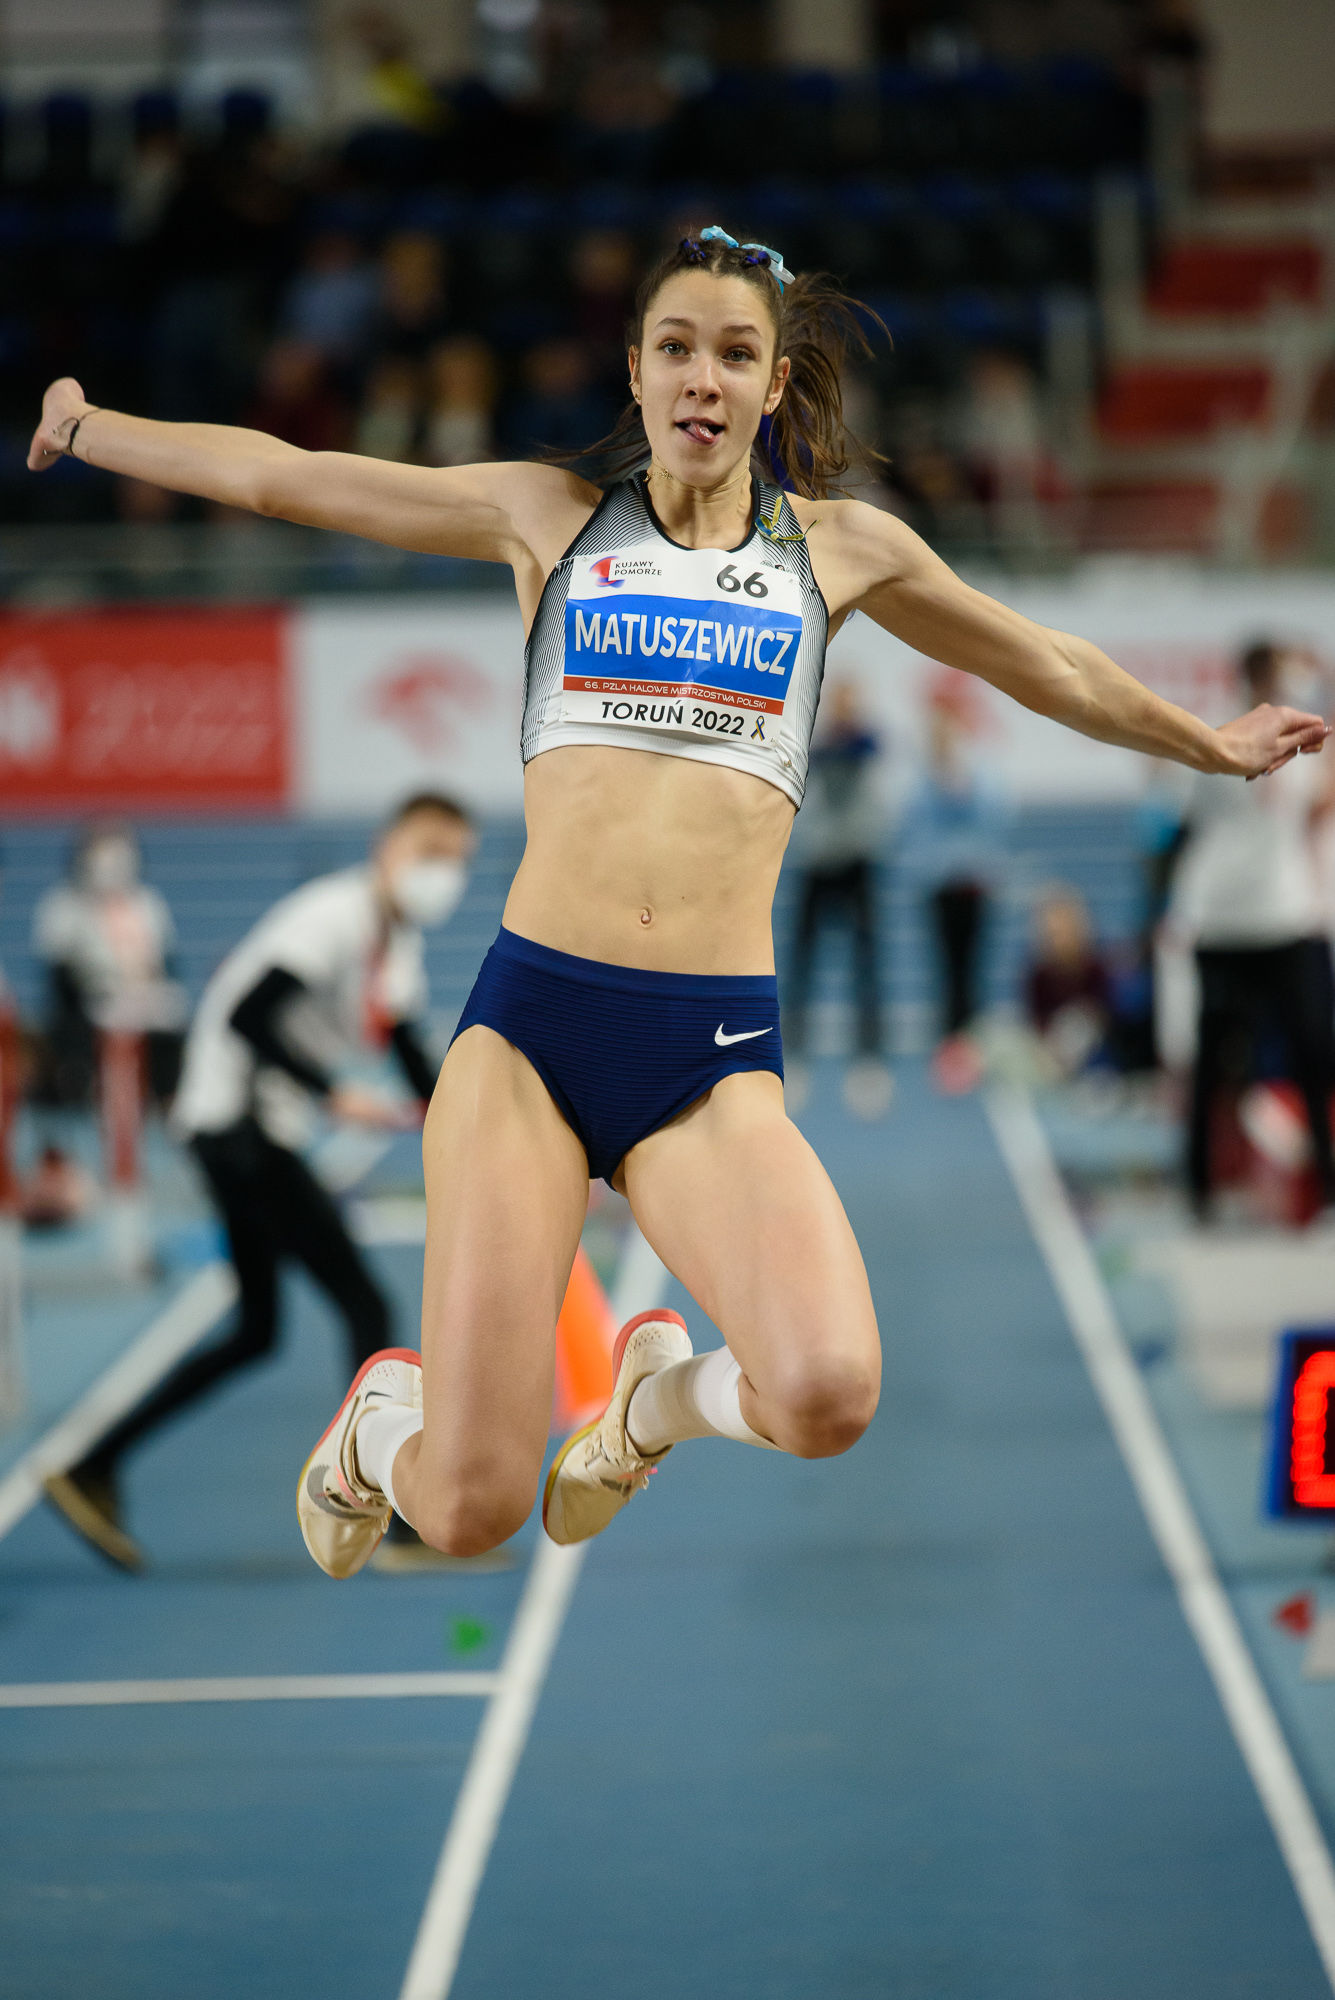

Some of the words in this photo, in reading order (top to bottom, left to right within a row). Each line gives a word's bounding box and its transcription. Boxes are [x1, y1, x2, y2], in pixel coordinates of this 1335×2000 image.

[614, 568, 663, 576] POMORZE
[615, 561, 654, 569] KUJAWY
[716, 564, 769, 598] 66
[575, 609, 793, 676] MATUSZEWICZ
[584, 681, 601, 689] 66.
[602, 682, 628, 691] PZLA
[629, 684, 669, 694] HALOWE
[670, 687, 735, 703] MISTRZOSTWA
[736, 697, 767, 709] POLSKI
[602, 700, 684, 724] TORUŃ
[691, 707, 745, 736] 2022
